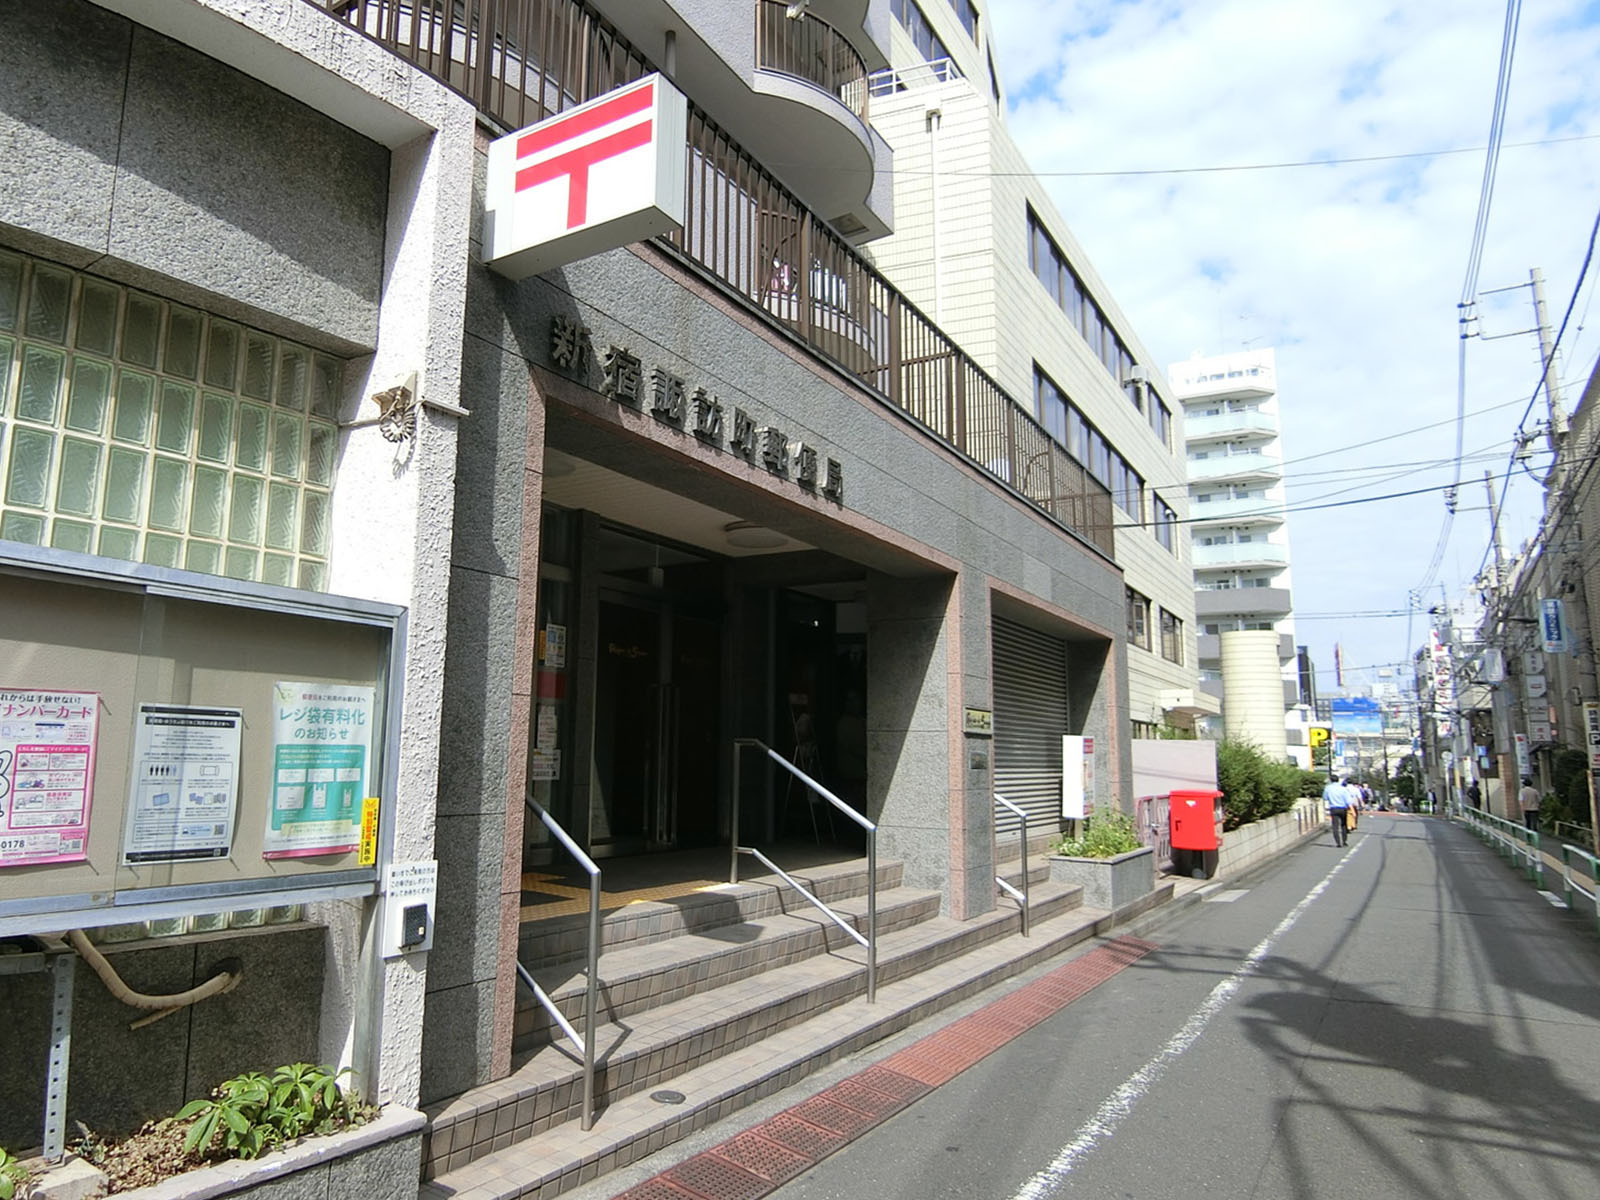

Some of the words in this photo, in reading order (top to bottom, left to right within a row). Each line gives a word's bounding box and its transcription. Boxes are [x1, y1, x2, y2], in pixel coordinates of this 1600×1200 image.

[551, 315, 843, 499] 新宿諏訪町郵便局
[280, 706, 366, 725] レジ袋有料化
[294, 727, 350, 741] のお知らせ
[1309, 727, 1329, 748] P
[1, 840, 25, 849] 0178
